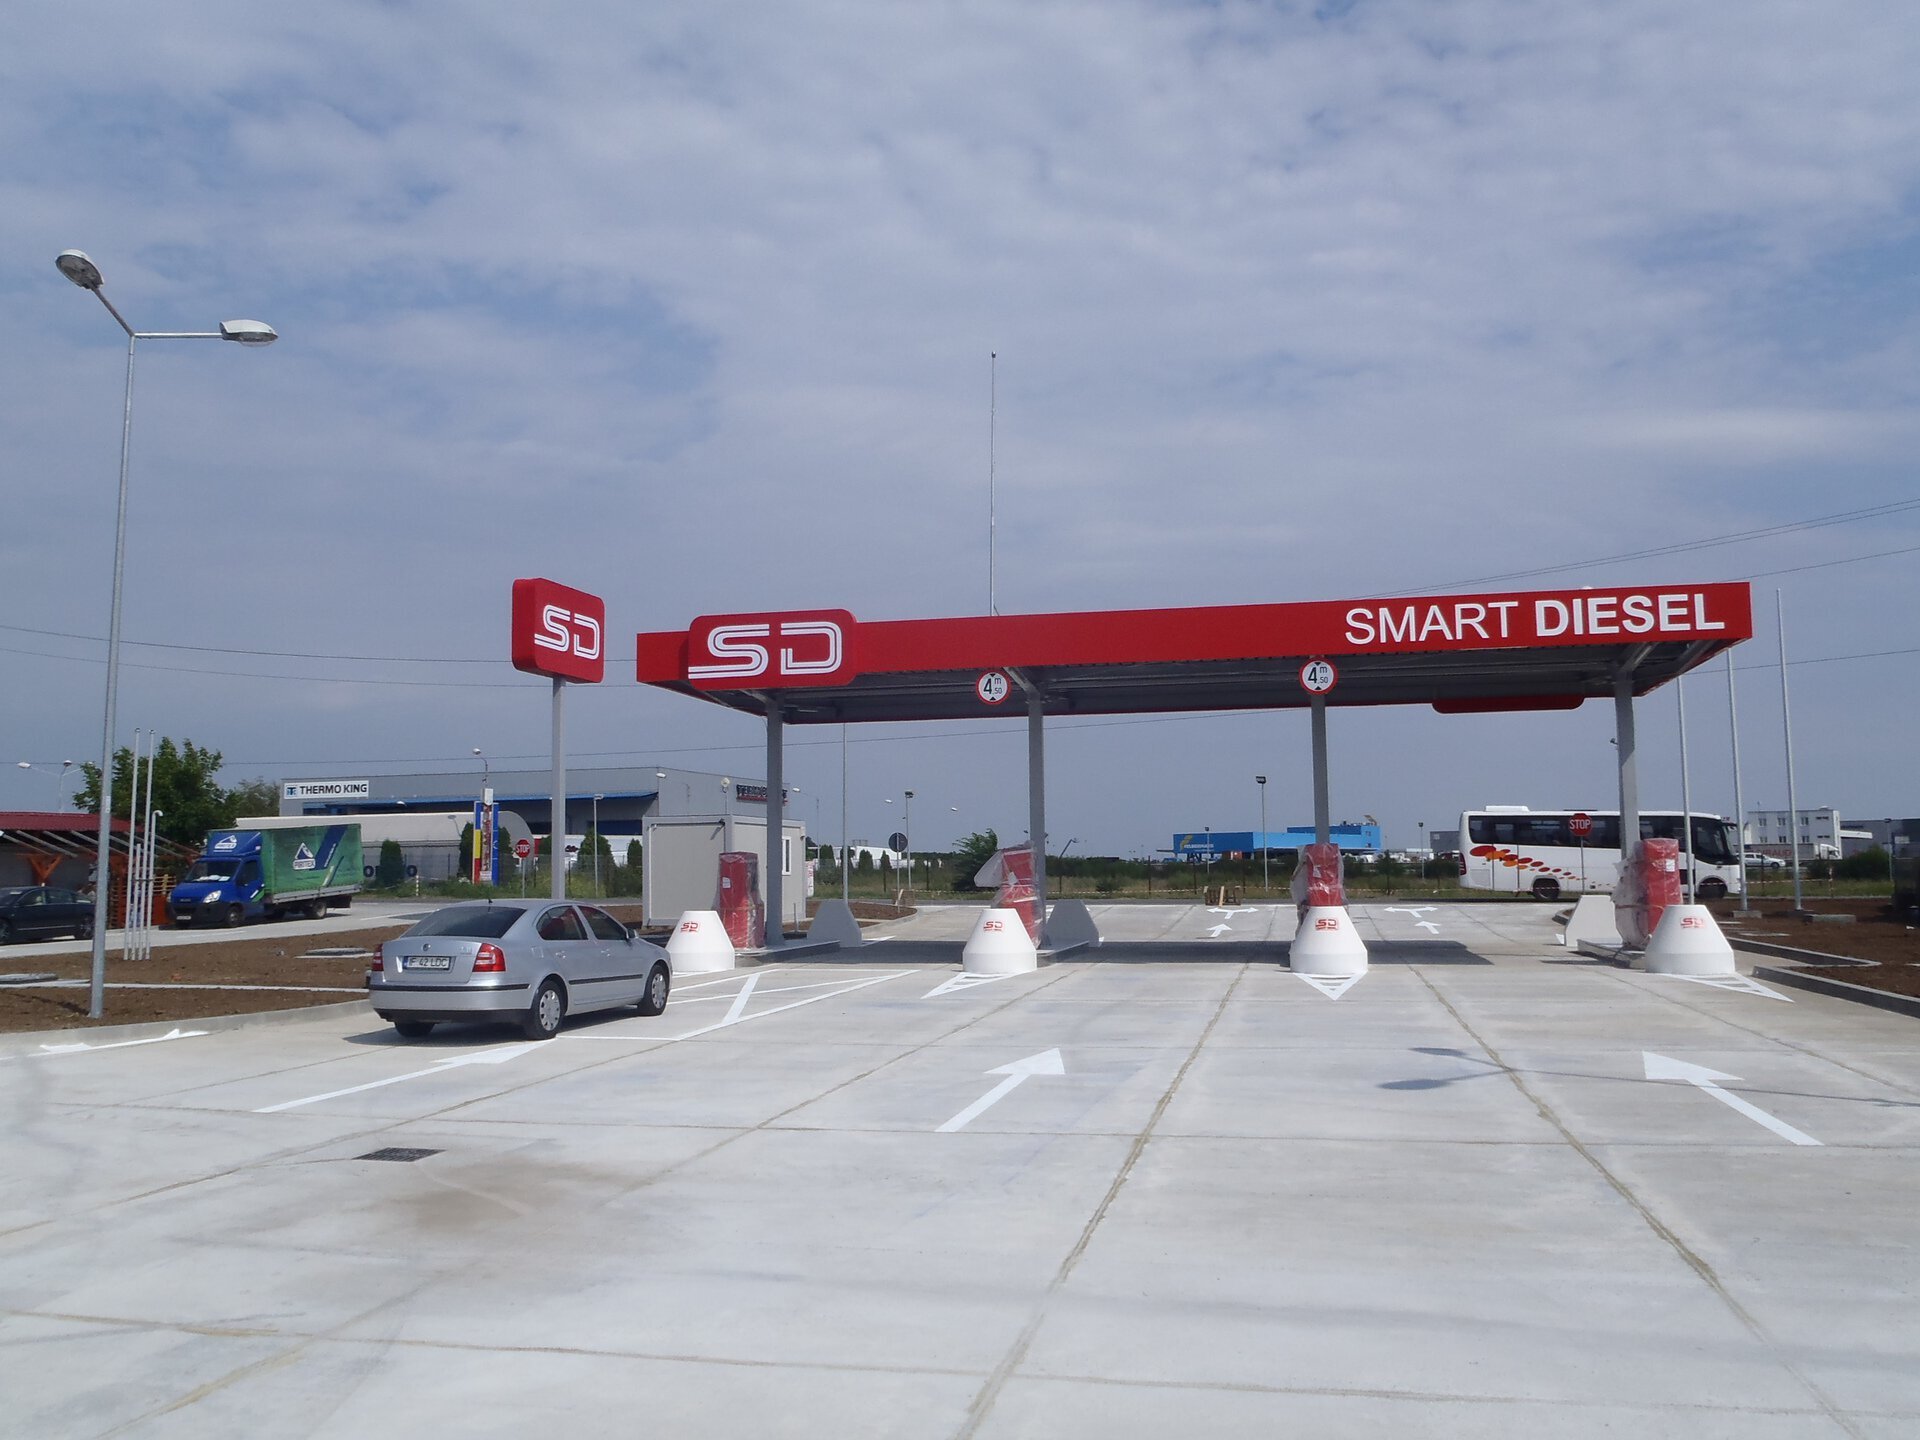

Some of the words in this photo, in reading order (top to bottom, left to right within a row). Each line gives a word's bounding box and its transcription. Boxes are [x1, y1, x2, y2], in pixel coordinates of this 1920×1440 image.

[1345, 601, 1519, 644] SMART
[1535, 593, 1725, 637] DIESEL
[534, 604, 599, 660] SD
[688, 621, 842, 679] SD
[1308, 667, 1317, 683] 4
[983, 678, 992, 694] 4
[300, 785, 341, 794] THERMO
[343, 783, 367, 793] KING
[1570, 819, 1591, 830] STOP
[516, 844, 530, 853] STOP
